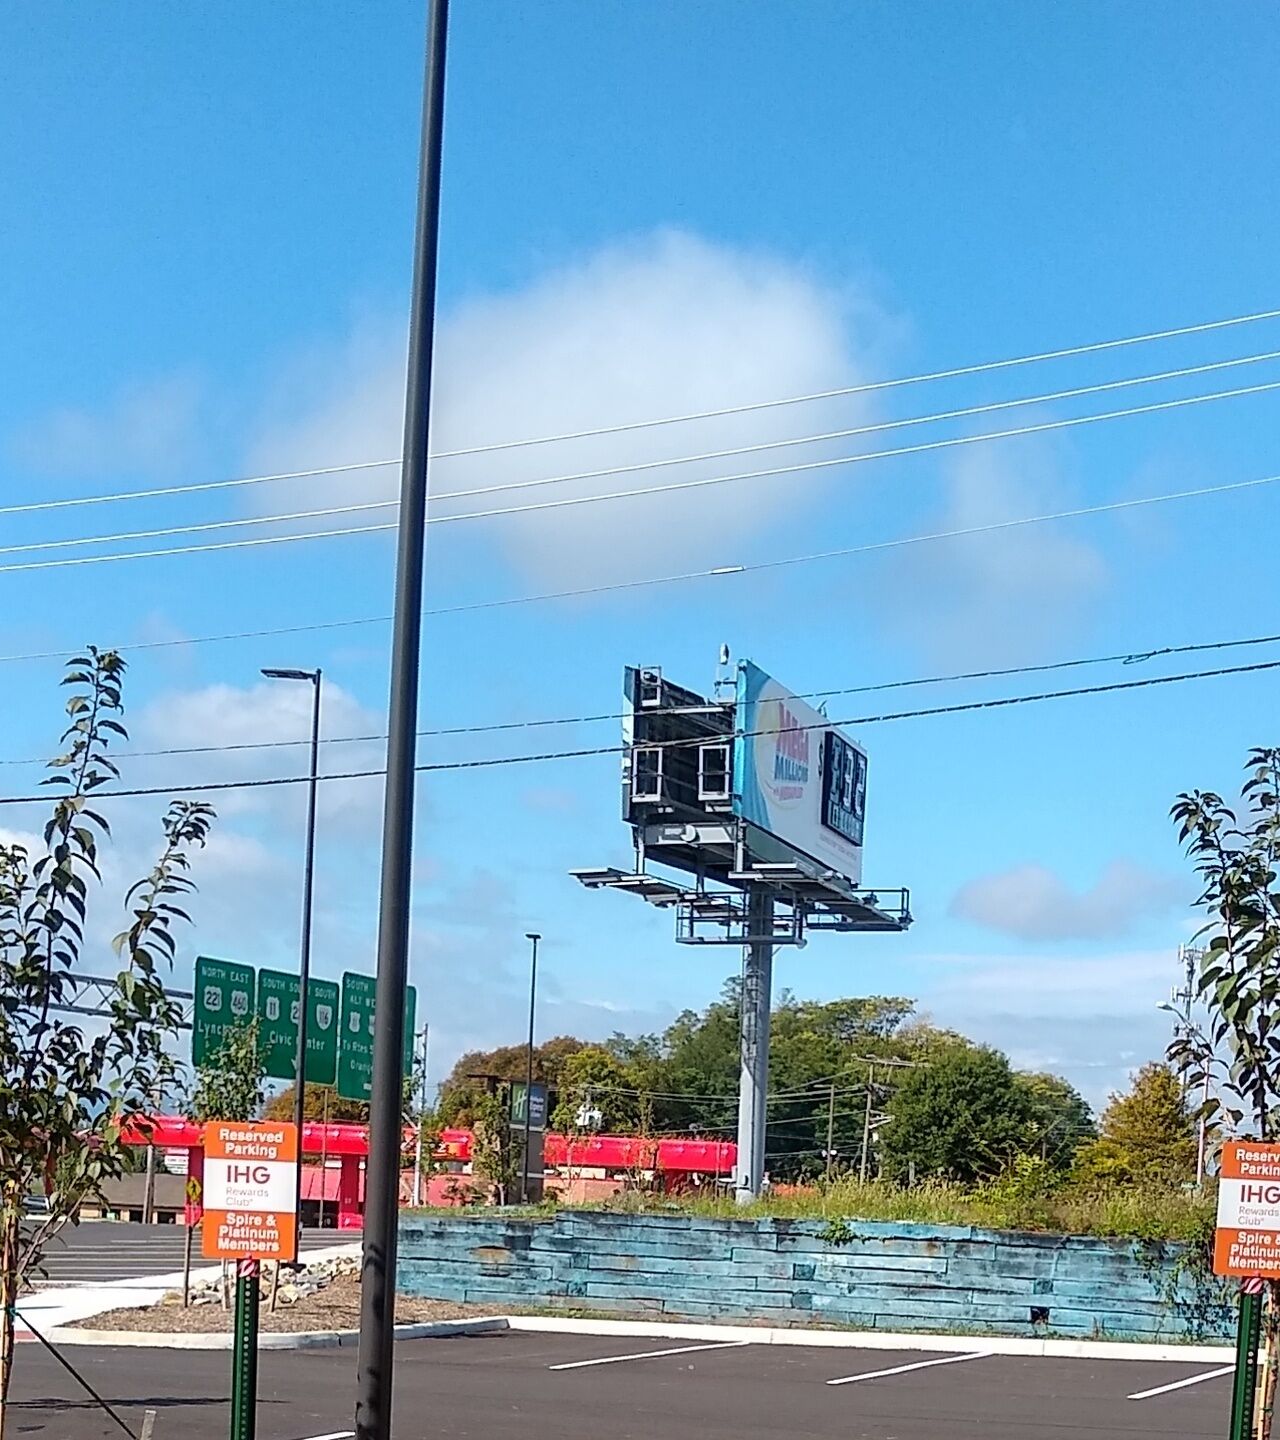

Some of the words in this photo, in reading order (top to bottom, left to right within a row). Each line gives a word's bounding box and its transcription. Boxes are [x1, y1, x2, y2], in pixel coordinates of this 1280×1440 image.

[201, 966, 226, 979] NORTH
[230, 971, 249, 984] EAST
[262, 977, 286, 991] SOUTH
[315, 987, 336, 1000] SOUTH
[269, 1030, 292, 1046] Civic
[350, 1059, 373, 1074] Orang
[219, 1128, 283, 1143] Reserved
[225, 1142, 277, 1158] Parking
[227, 1165, 270, 1184] IHG
[226, 1187, 269, 1198] Rewards
[1239, 1206, 1280, 1217] Rewards
[226, 1212, 262, 1226] Spire
[266, 1214, 276, 1227] &
[219, 1225, 278, 1240] Platinum
[1238, 1231, 1271, 1245] Spire
[218, 1238, 280, 1252] Members
